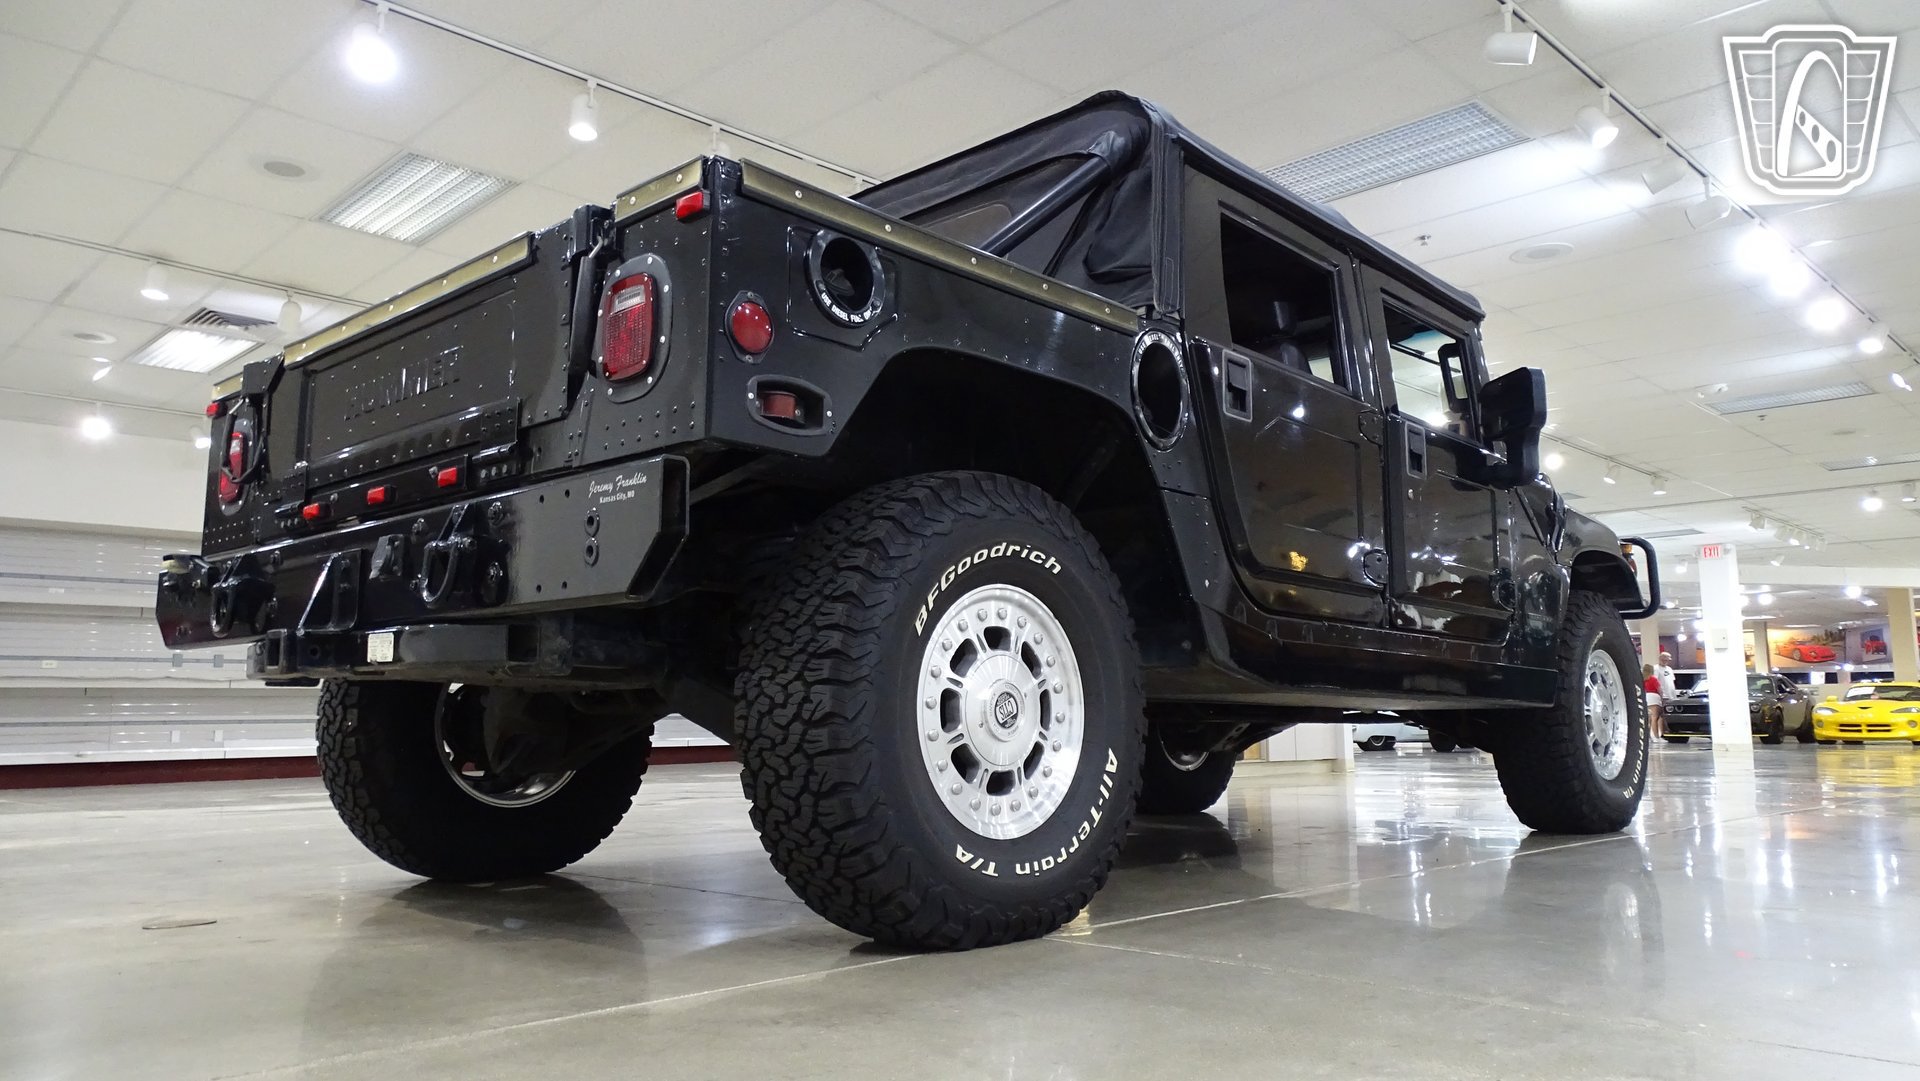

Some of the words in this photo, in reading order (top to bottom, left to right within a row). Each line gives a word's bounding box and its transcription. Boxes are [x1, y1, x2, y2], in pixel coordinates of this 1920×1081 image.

[821, 292, 832, 306] USE
[831, 304, 849, 321] DIESEL
[588, 480, 613, 498] Jeremy
[616, 472, 647, 491] Franklin
[599, 495, 616, 503] Kansas
[1703, 545, 1720, 559] EXIT
[914, 541, 1063, 637] BFGoodrich
[1633, 683, 1645, 784] All-Terrain
[1622, 785, 1636, 799] T/A
[1015, 746, 1120, 877] All-Terrain
[954, 843, 998, 878] T/A
